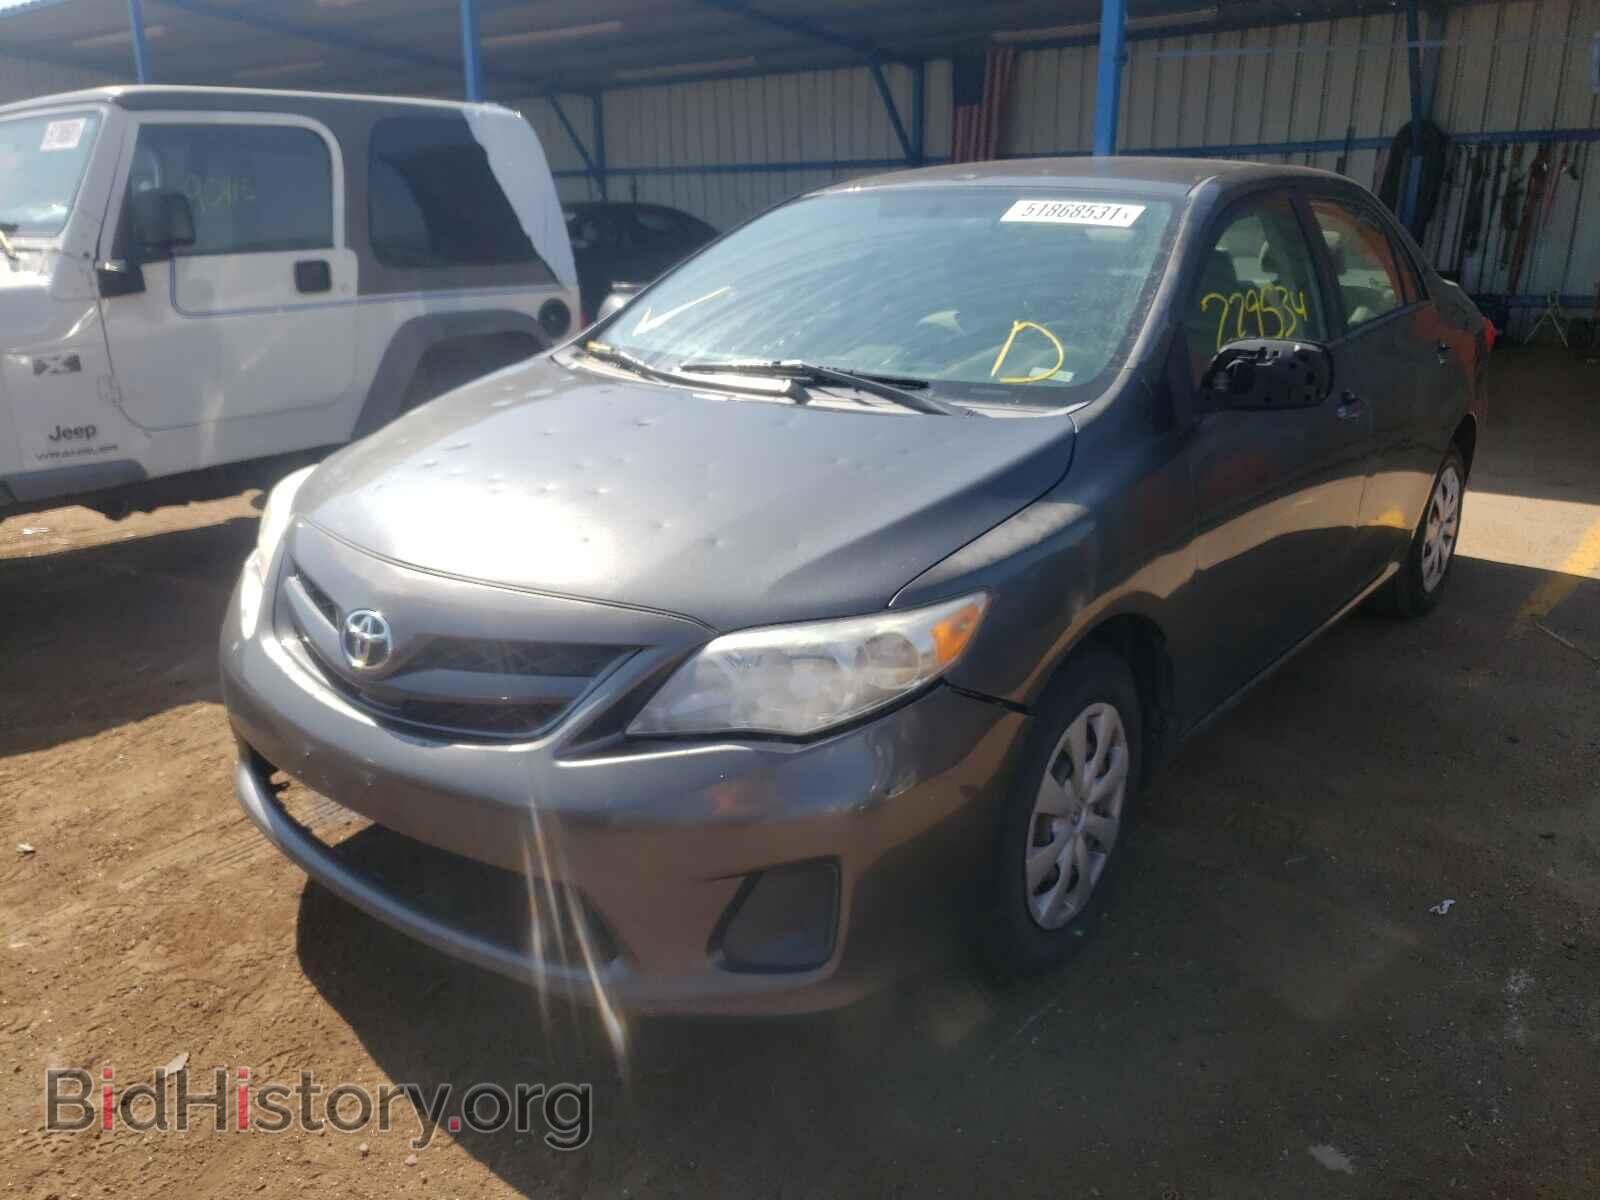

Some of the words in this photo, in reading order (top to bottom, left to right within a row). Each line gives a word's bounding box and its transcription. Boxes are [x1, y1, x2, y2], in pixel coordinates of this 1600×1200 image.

[1021, 202, 1122, 221] 51868531
[990, 319, 1065, 384] D
[47, 424, 97, 442] Jeep
